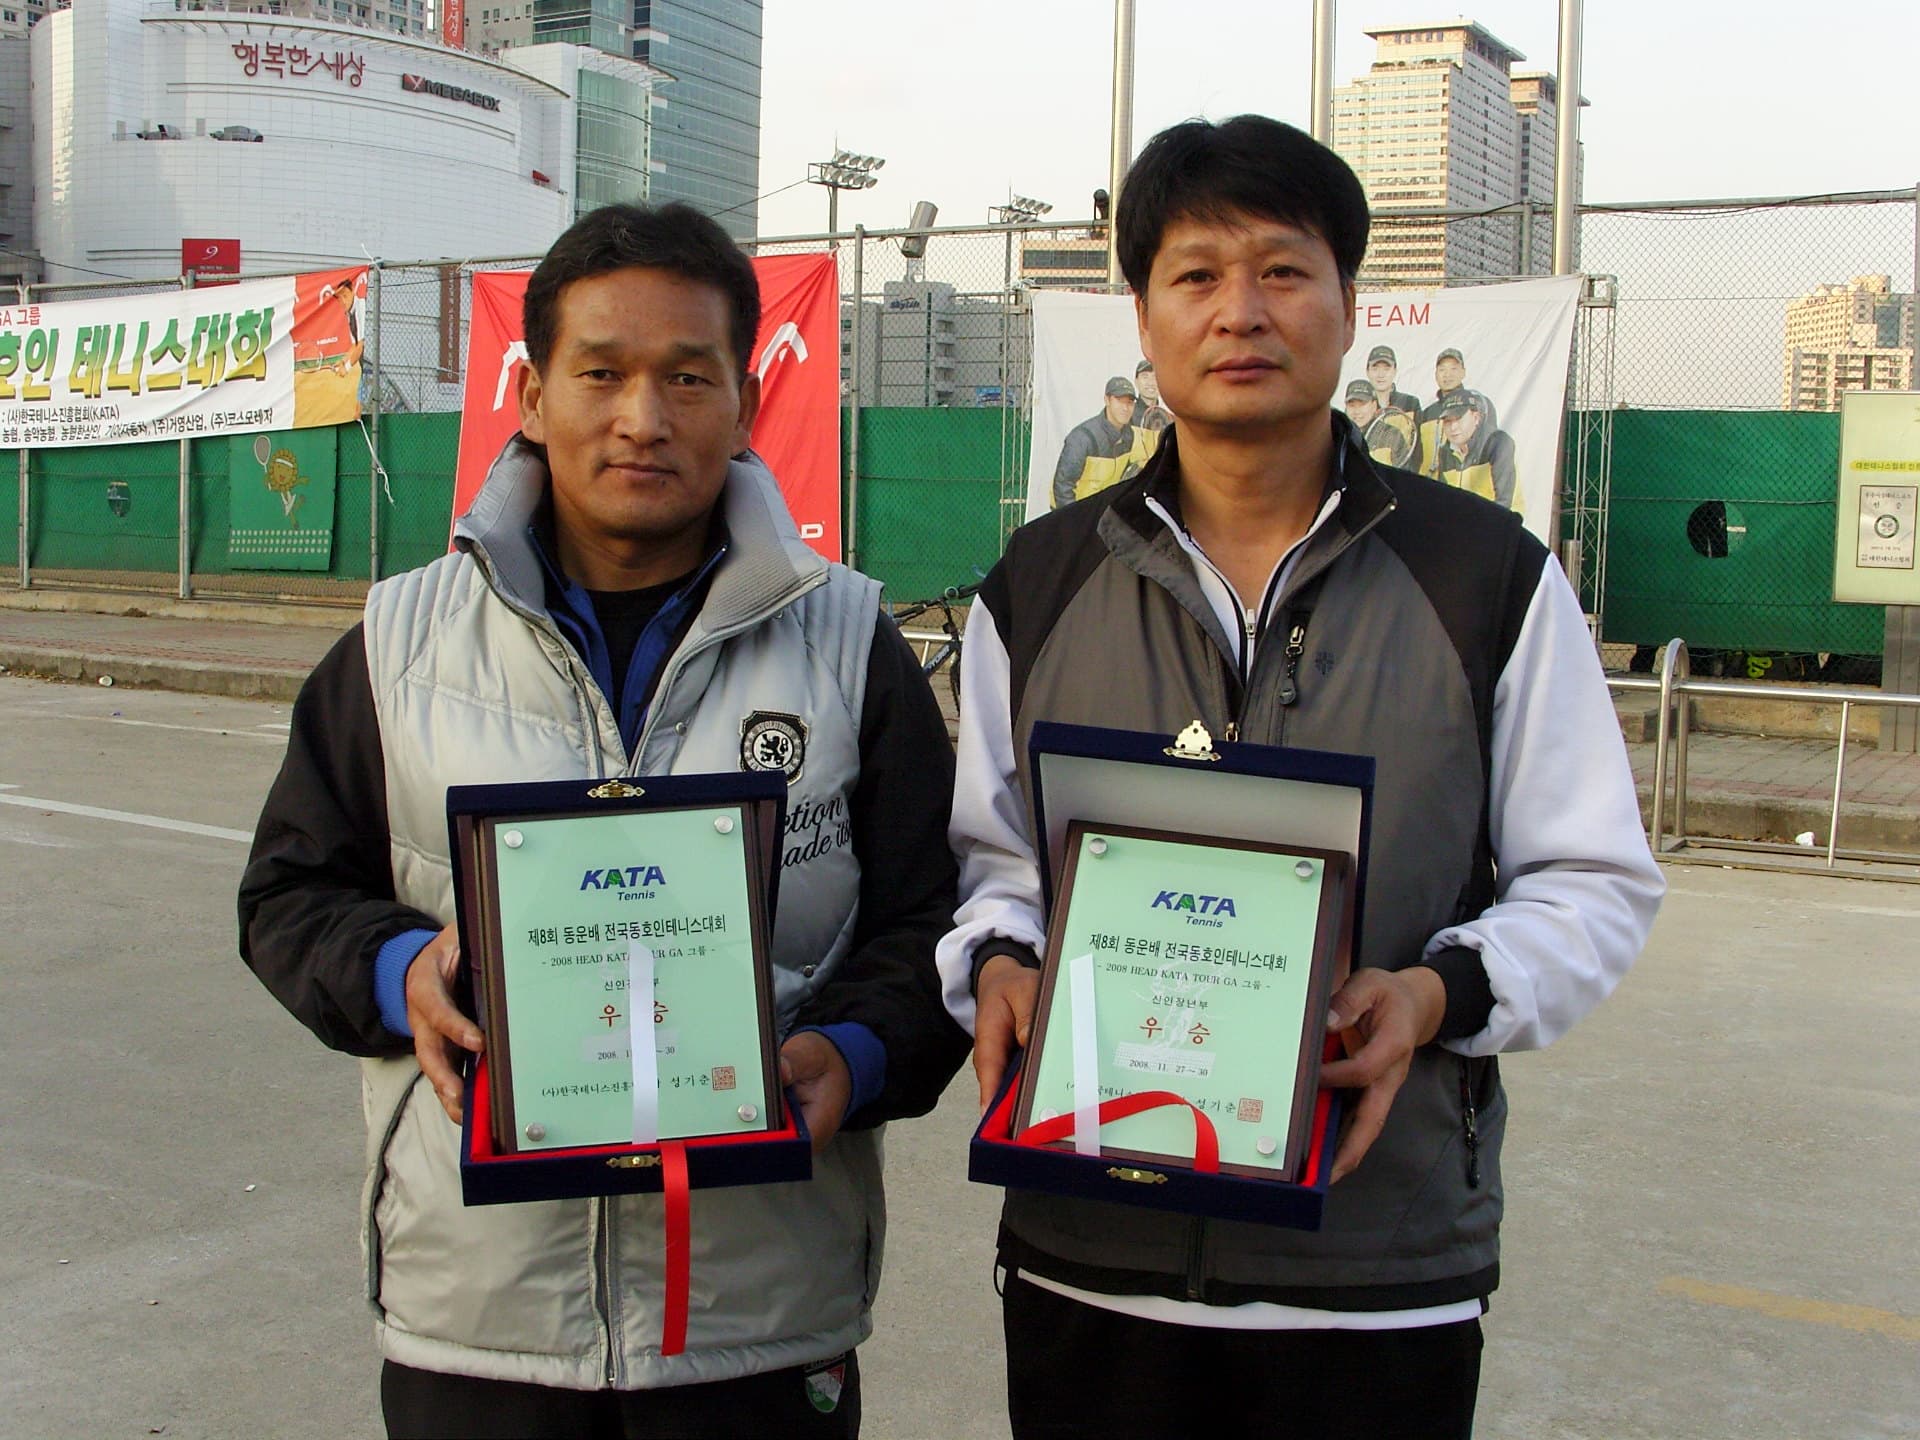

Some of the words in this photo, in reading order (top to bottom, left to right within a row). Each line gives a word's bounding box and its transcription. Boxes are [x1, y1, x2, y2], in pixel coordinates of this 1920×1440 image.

[232, 40, 366, 87] 행복한세상
[0, 310, 12, 326] A
[17, 306, 41, 326] 그룹
[1355, 303, 1430, 327] EAM
[69, 307, 275, 399] 테니스대회
[781, 824, 832, 869] ade
[580, 866, 666, 891] KATA
[617, 889, 656, 901] Tennis
[1151, 890, 1237, 918] KATA
[528, 927, 558, 946] 제8회
[563, 924, 600, 945] 동운배
[604, 914, 727, 942] 전국동호인테니스대회
[1185, 915, 1224, 928] Tennis
[551, 957, 573, 967] 2008
[576, 954, 603, 965] HEAD
[606, 952, 630, 963] KAT
[651, 949, 665, 959] UR
[669, 948, 683, 957] GA
[687, 945, 706, 956] 그룹
[1089, 933, 1120, 953] 제8회
[1124, 937, 1161, 957] 동운배
[1164, 942, 1288, 972] 전국동호인테니스대회
[1106, 963, 1128, 973] 2008
[1131, 966, 1158, 977] HEAD
[1161, 970, 1189, 981] KATA
[1193, 974, 1220, 985] TOUR
[1223, 977, 1238, 987] GA
[1152, 994, 1209, 1010] 신인장년부
